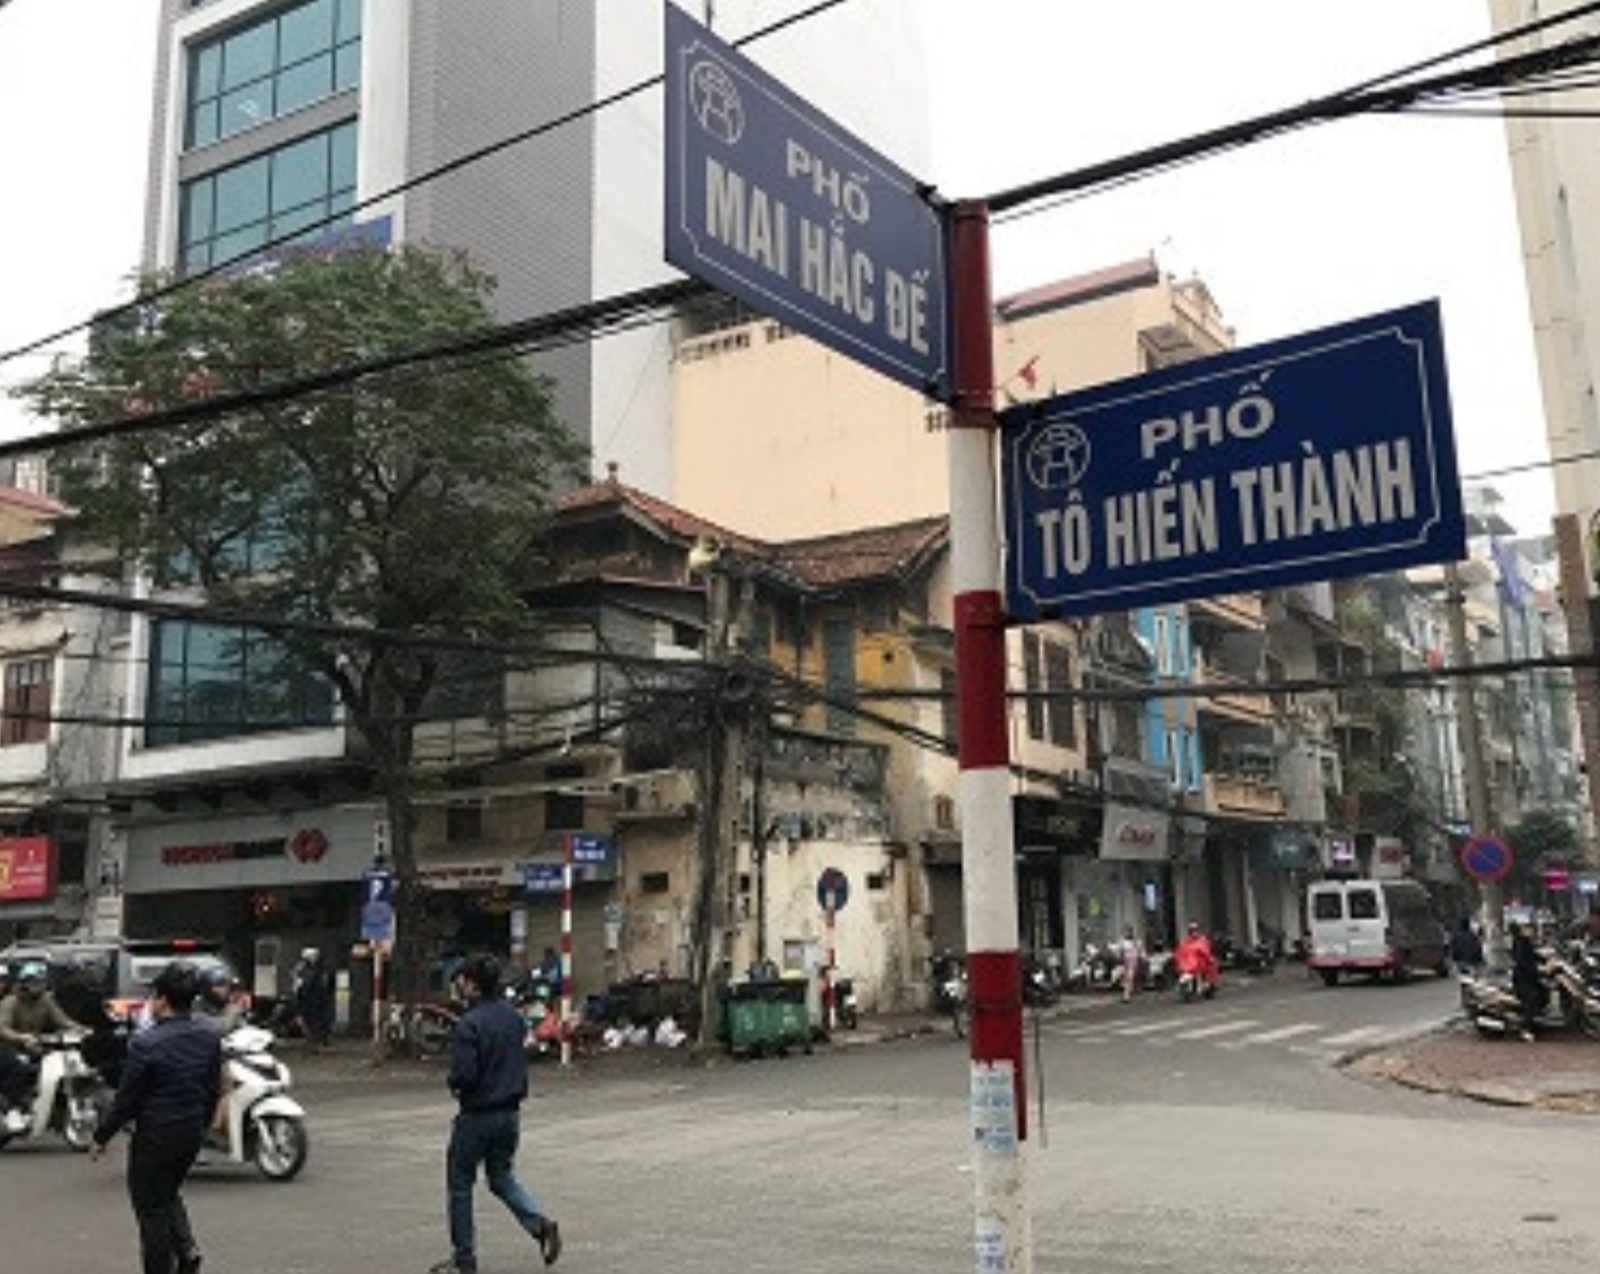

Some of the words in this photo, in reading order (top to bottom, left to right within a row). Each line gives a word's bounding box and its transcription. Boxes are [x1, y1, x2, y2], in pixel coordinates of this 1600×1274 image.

[787, 139, 870, 225] PHỐ
[705, 156, 787, 279] MAI
[800, 213, 875, 324] HẮC
[885, 268, 930, 356] ĐẾ
[1141, 369, 1275, 460] PHỐ
[1036, 488, 1093, 579] TÔ
[1105, 459, 1219, 569] HIẾN
[1230, 438, 1416, 545] THÀNH
